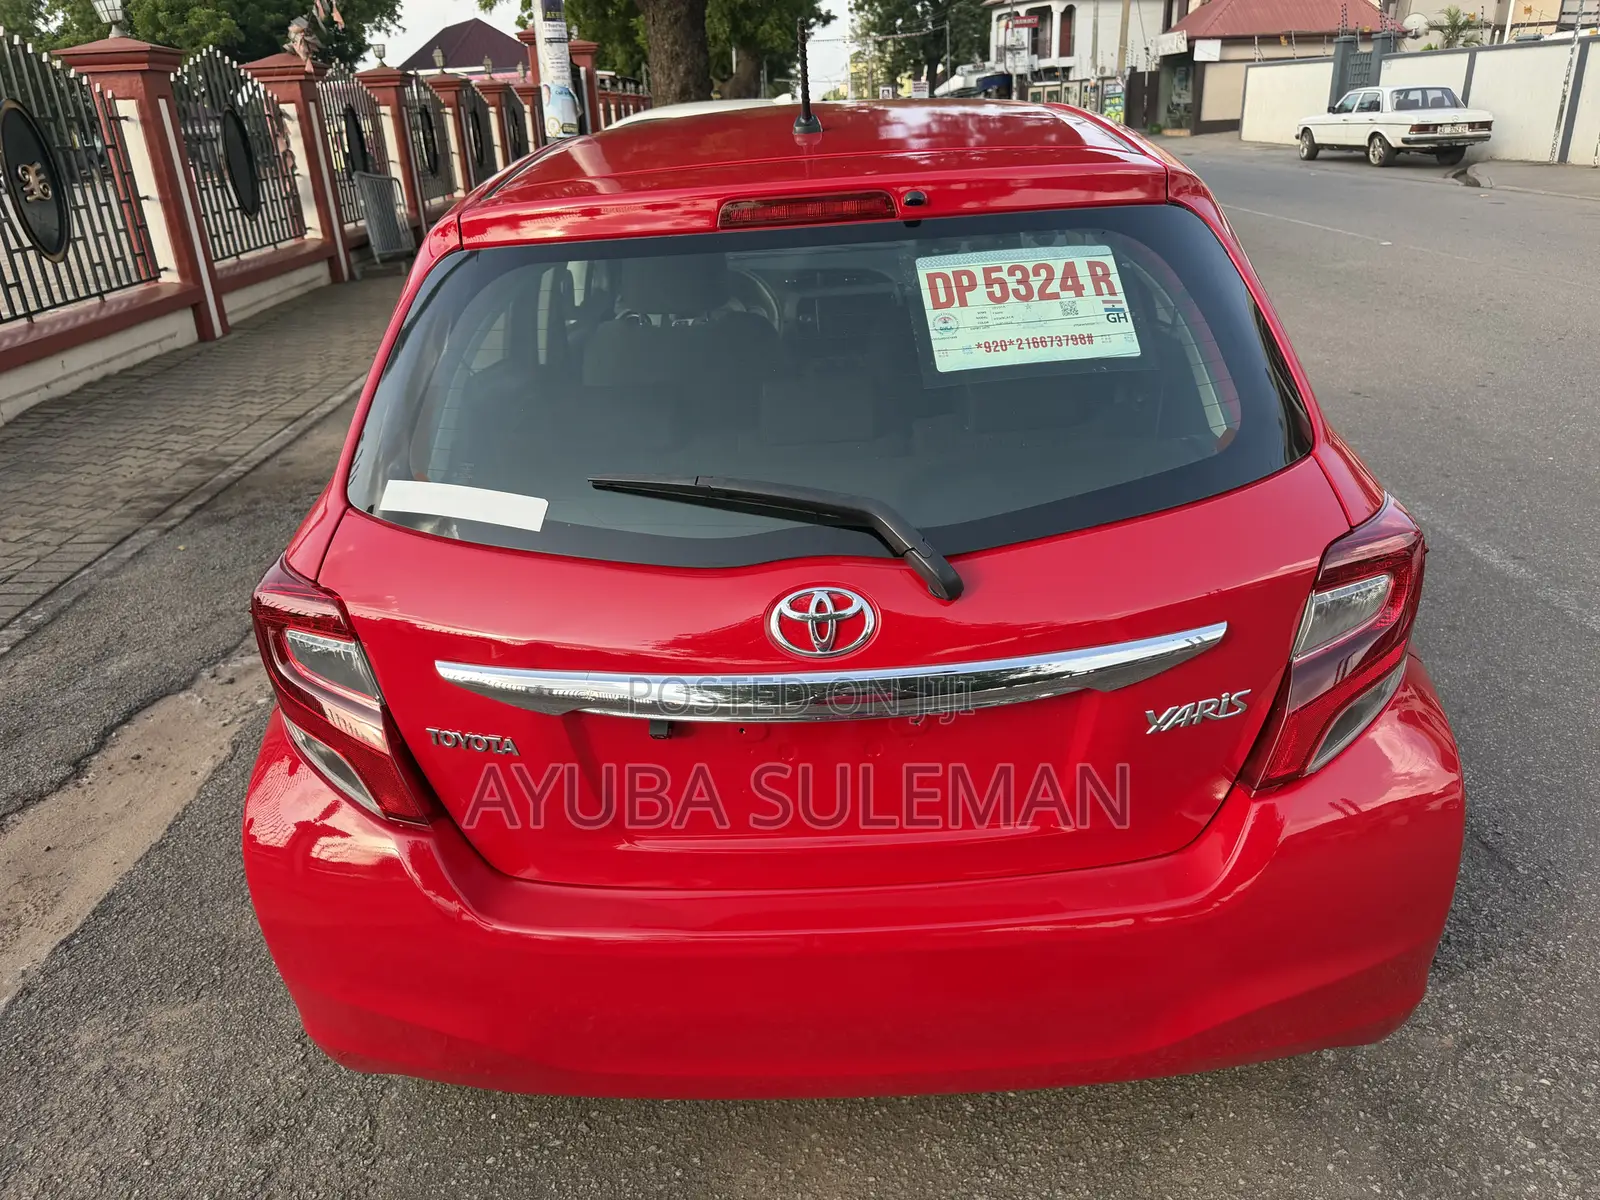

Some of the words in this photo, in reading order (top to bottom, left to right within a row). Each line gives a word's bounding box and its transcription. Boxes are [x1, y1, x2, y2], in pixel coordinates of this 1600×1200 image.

[926, 269, 978, 310] DP
[982, 261, 1085, 304] 5324
[1086, 260, 1118, 297] R
[1106, 313, 1128, 323] GH
[425, 727, 520, 756] TOYOTA
